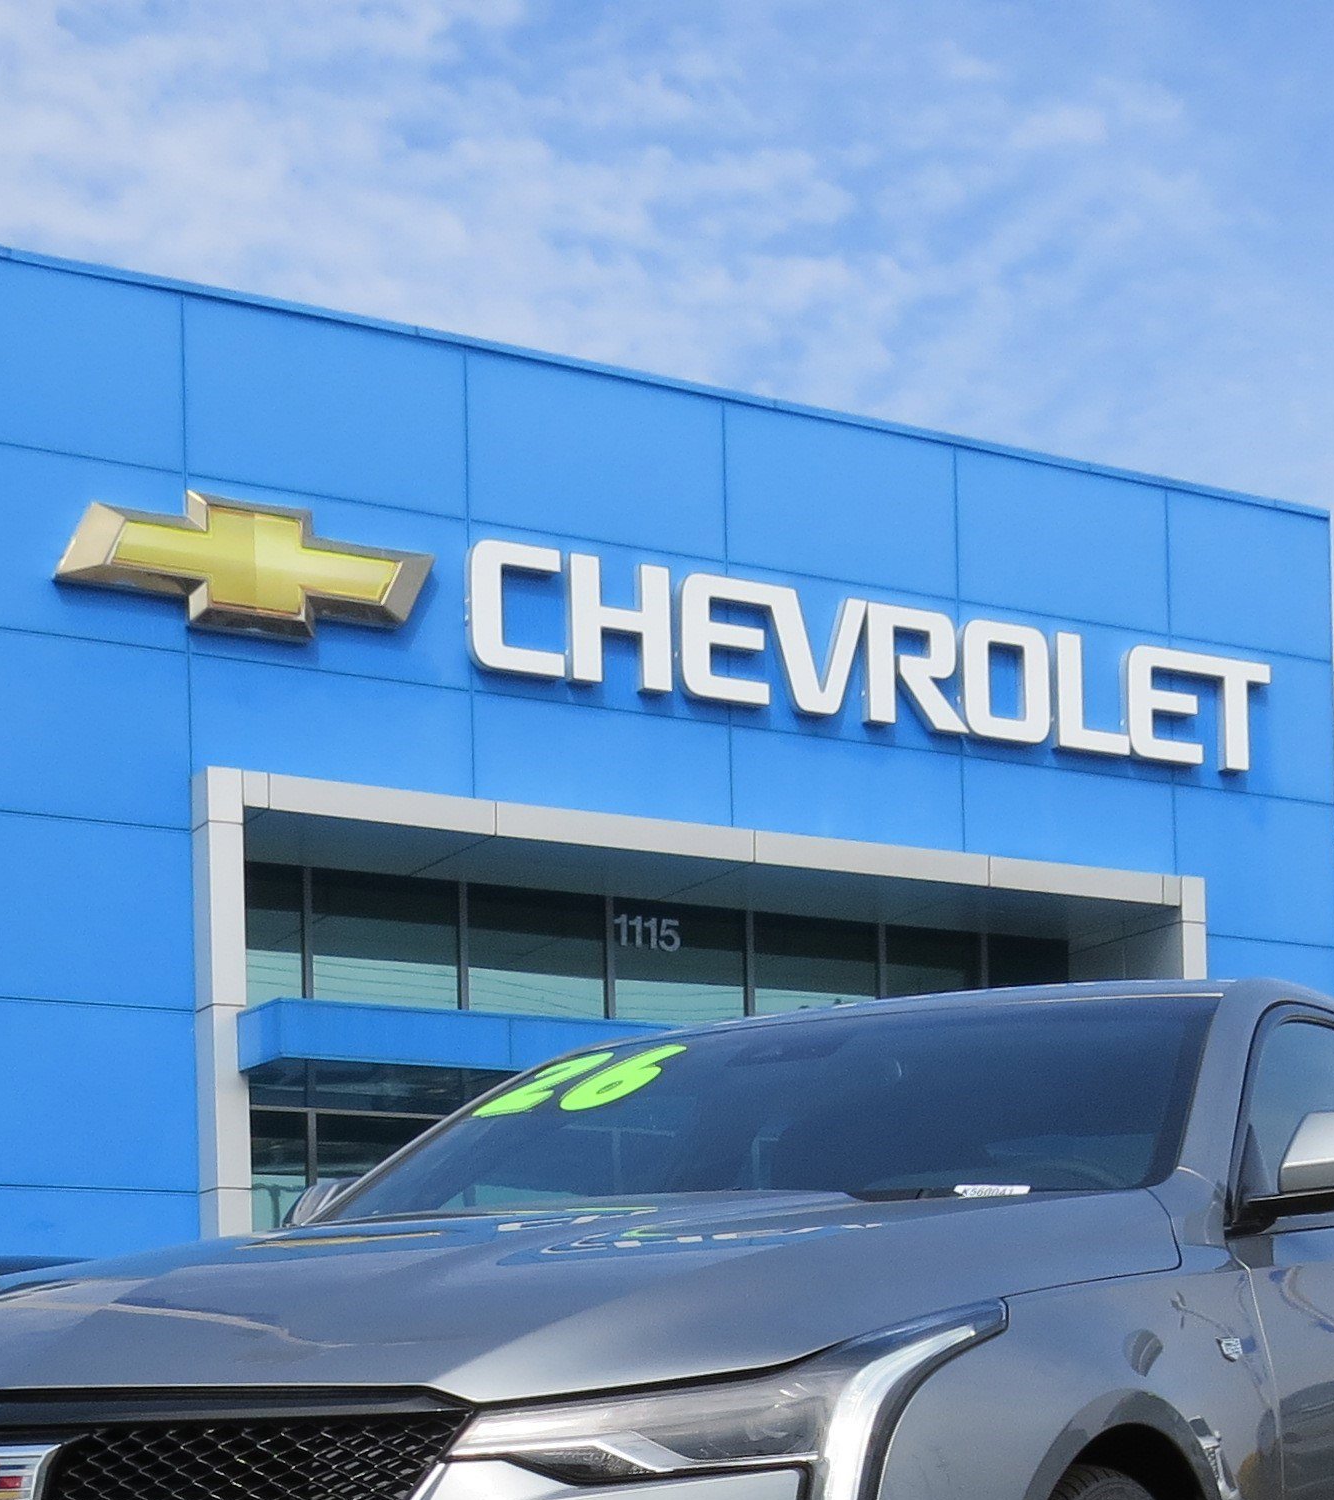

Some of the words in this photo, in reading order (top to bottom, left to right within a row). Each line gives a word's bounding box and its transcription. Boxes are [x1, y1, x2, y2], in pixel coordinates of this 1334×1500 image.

[468, 539, 1271, 773] CHEVROLET
[614, 913, 682, 952] 1115
[470, 1043, 689, 1119] 26
